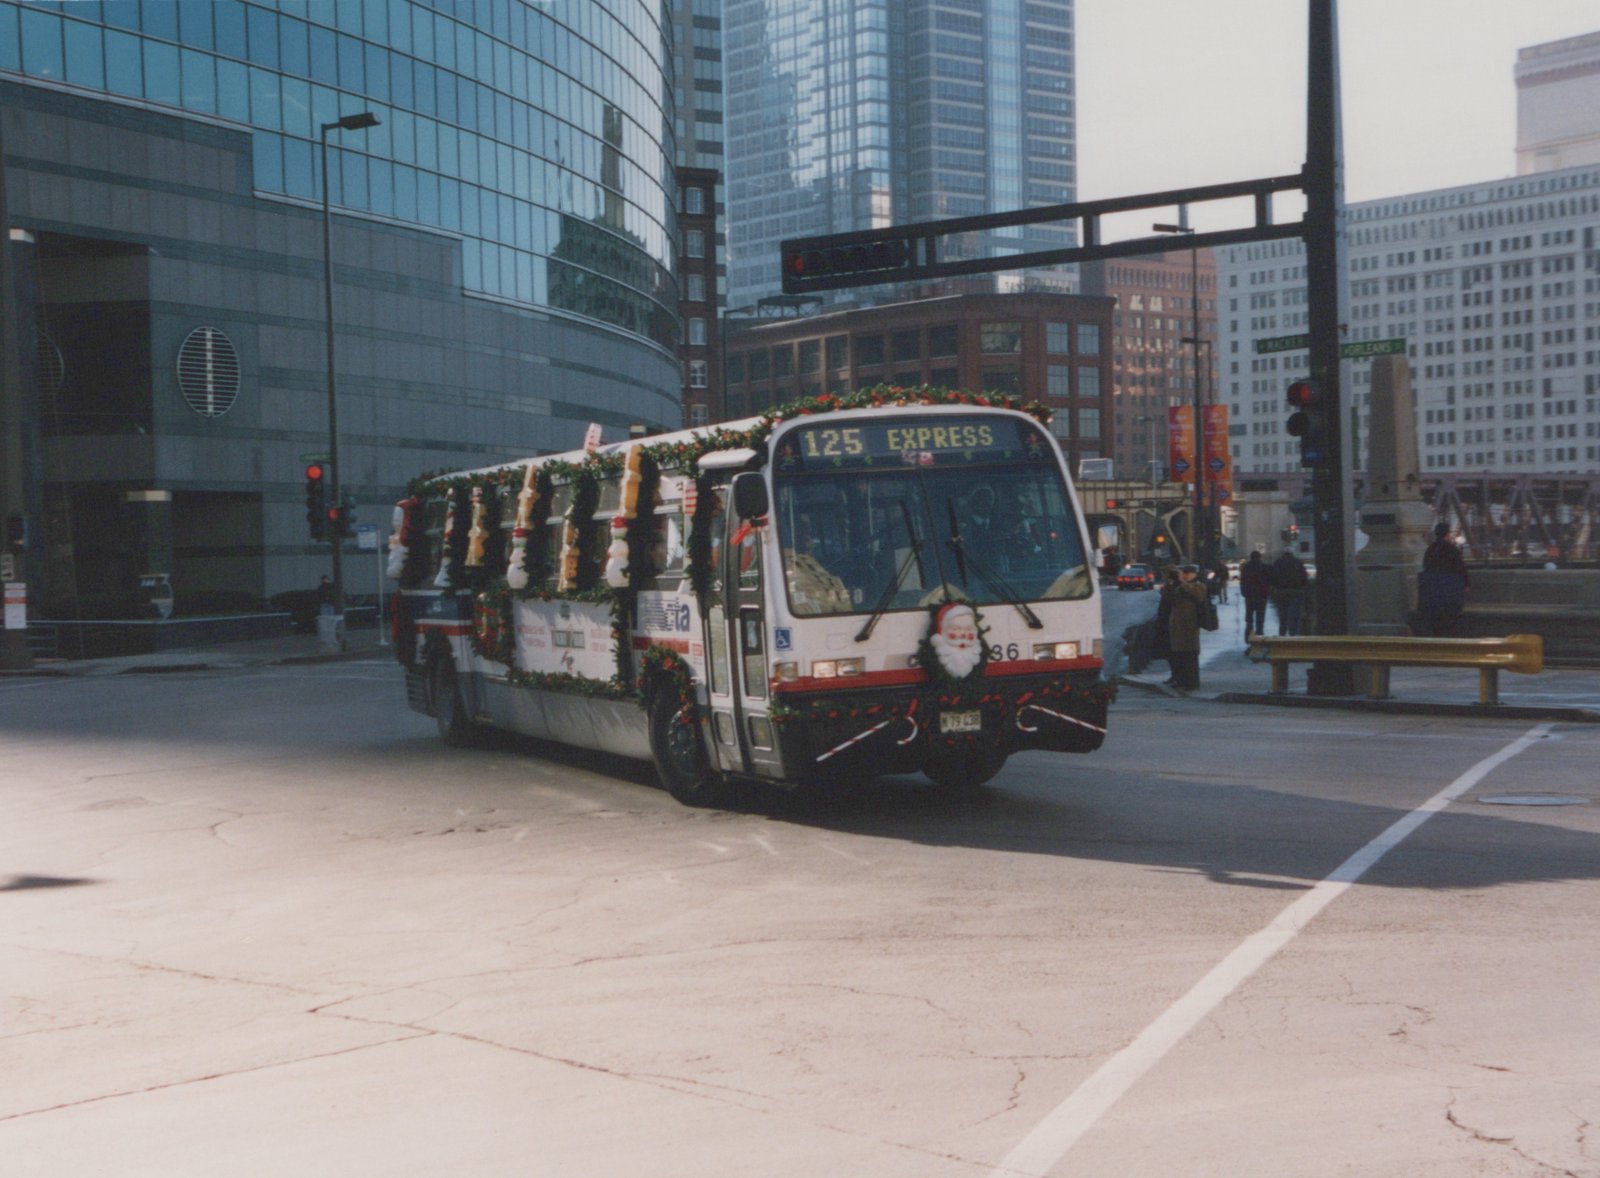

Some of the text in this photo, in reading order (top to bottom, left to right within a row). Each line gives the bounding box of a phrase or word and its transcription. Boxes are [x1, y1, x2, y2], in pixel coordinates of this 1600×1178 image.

[1349, 342, 1392, 356] ORLEANS
[804, 425, 993, 457] 125 EXPRESS
